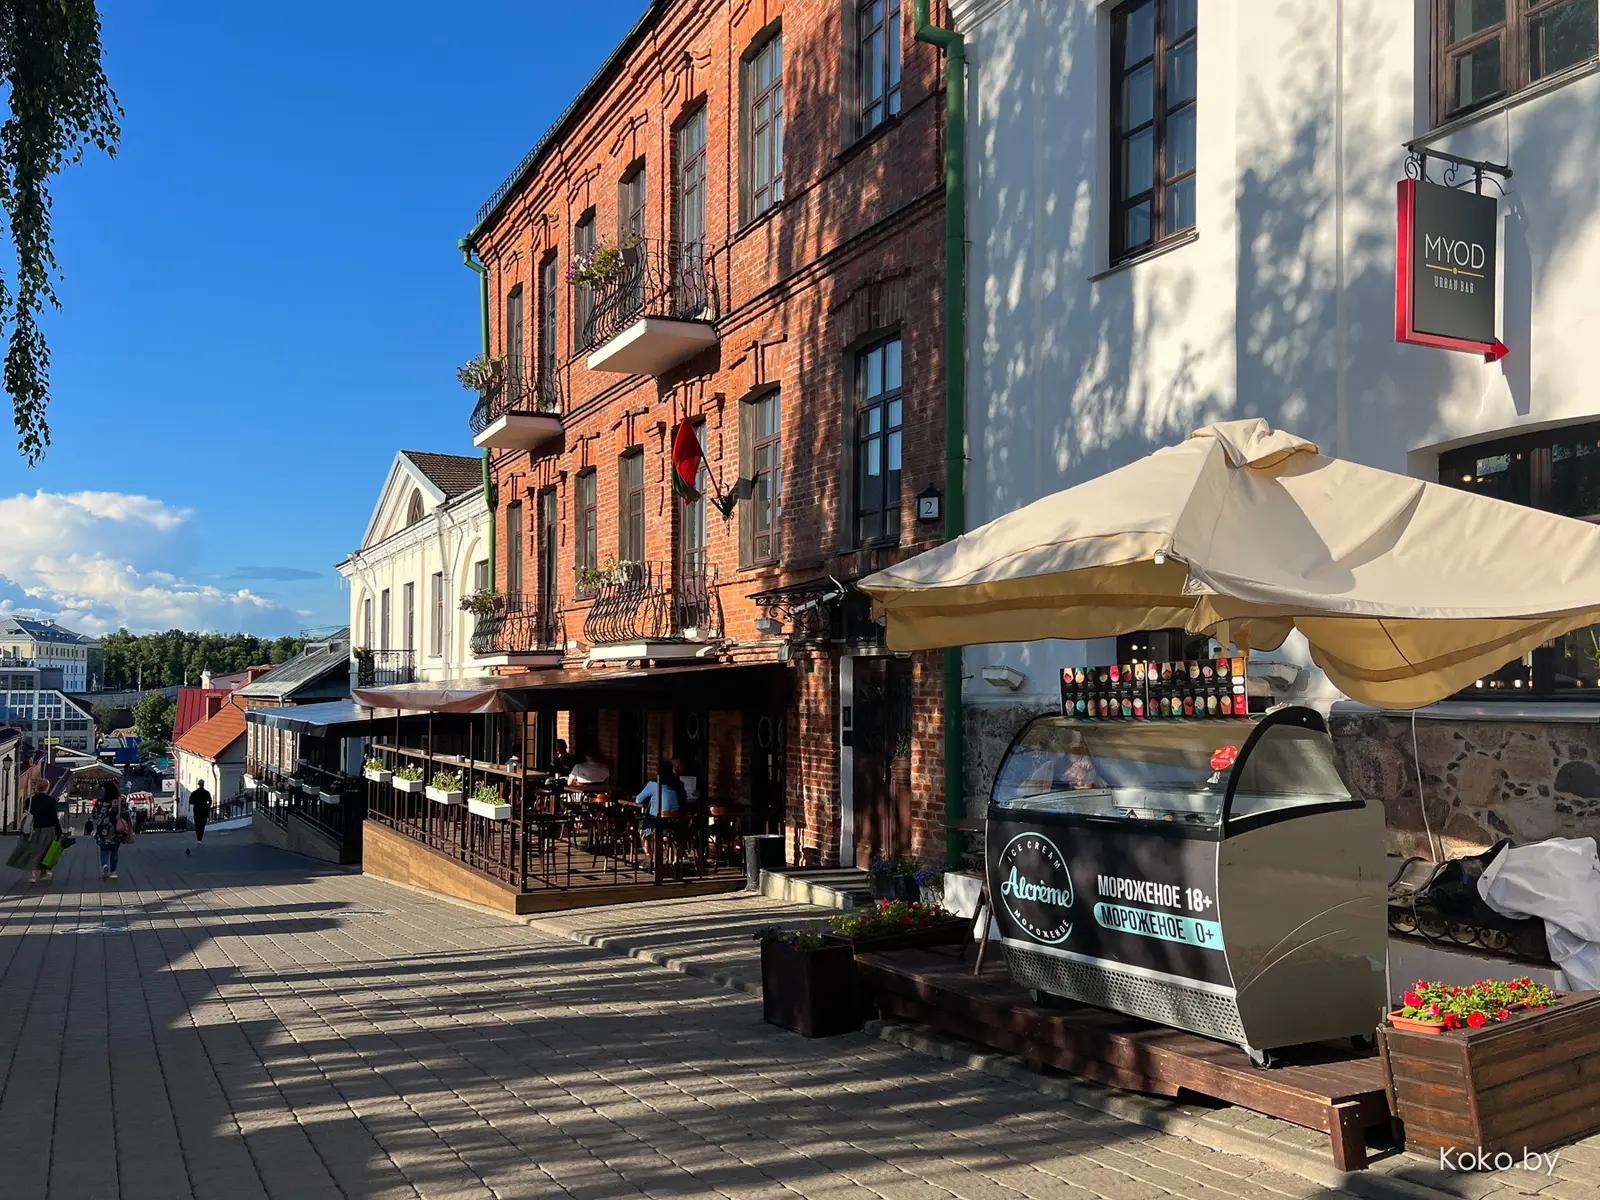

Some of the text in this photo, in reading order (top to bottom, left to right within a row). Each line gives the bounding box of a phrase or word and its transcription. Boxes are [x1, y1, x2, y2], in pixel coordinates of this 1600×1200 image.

[1425, 233, 1485, 270] MYOD
[1434, 275, 1474, 294] URBAN BAR
[924, 501, 933, 515] 2
[1007, 840, 1061, 870] ICE CREAM
[1098, 874, 1213, 912] МОРОЖЕНОЕ 18+
[1014, 909, 1070, 938] МОРОЖЕНОЕ
[1101, 905, 1215, 944] МОРОЖЕНОЕ 0+
